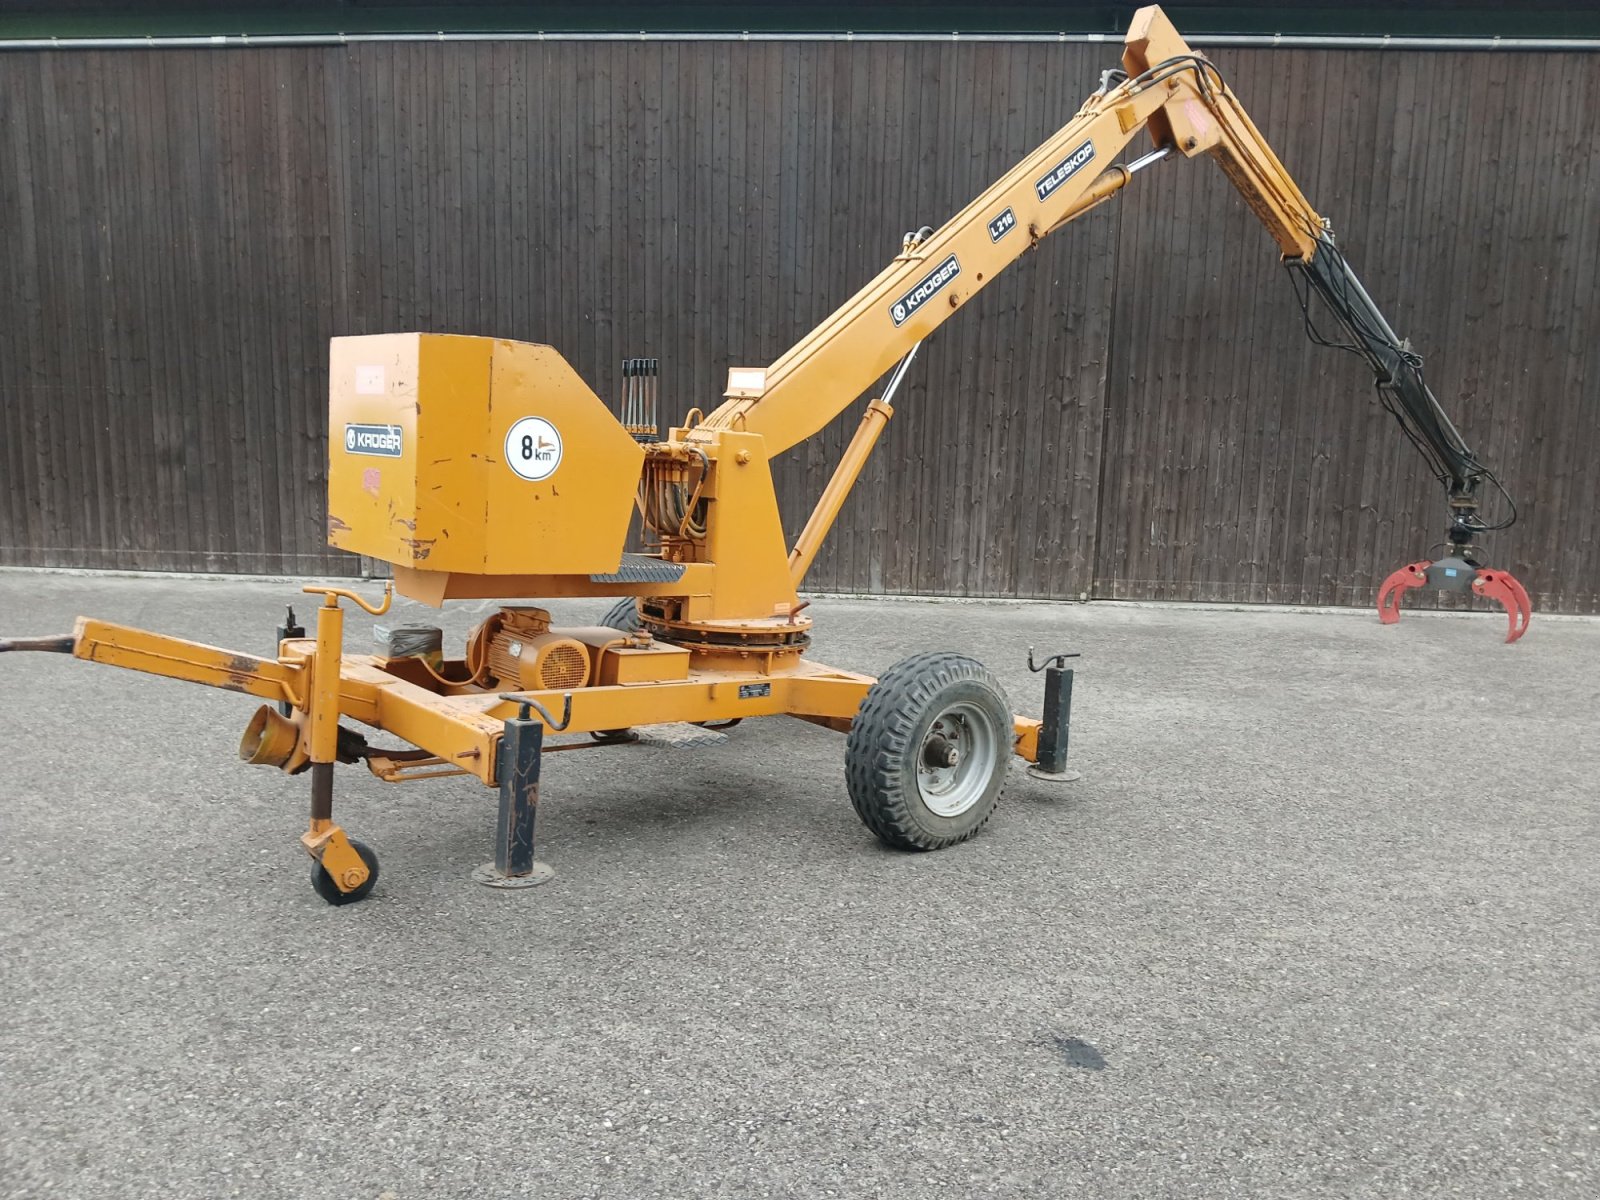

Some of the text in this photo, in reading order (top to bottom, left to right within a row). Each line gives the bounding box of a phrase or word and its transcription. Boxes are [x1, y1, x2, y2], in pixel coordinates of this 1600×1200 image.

[1038, 143, 1092, 195] TELESKOP
[521, 434, 551, 460] 8 km
